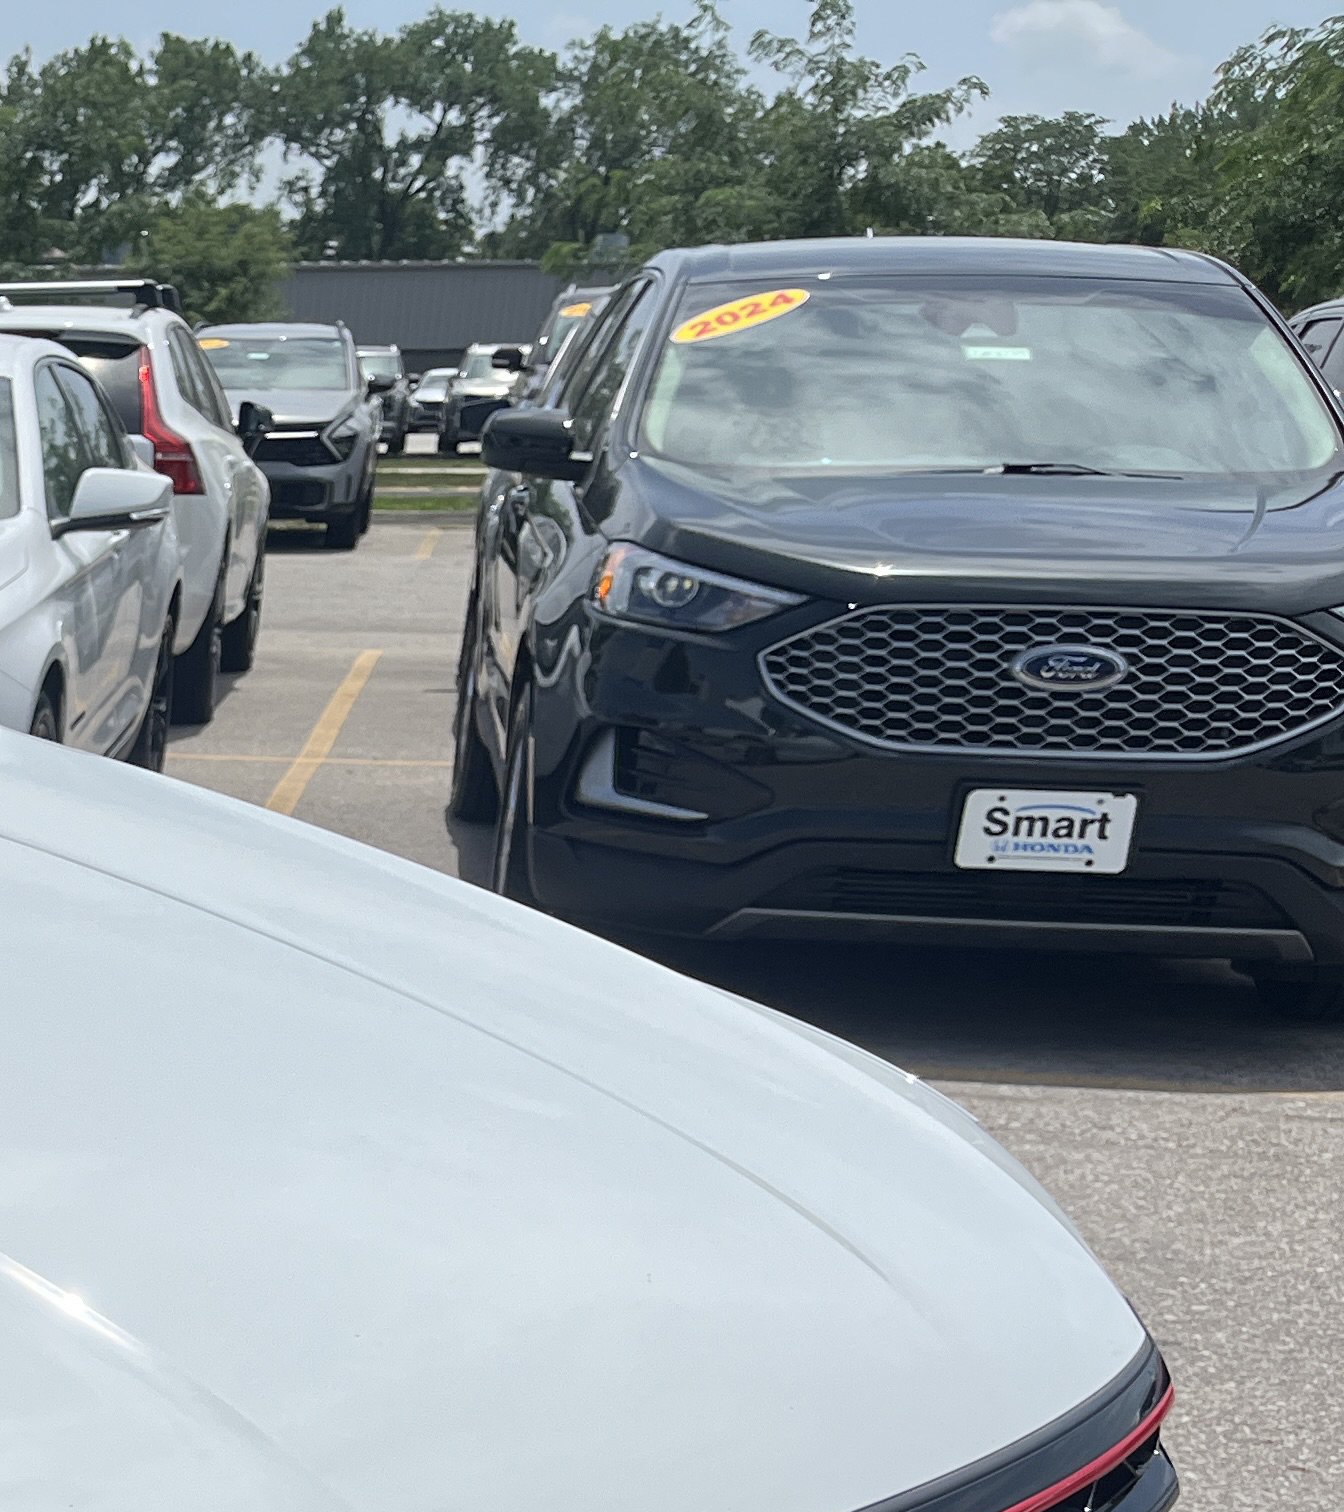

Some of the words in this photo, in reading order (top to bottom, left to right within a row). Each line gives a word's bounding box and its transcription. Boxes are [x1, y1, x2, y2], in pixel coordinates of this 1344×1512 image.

[689, 293, 796, 338] 2024
[1040, 654, 1103, 679] Ford
[983, 806, 1111, 840] Smart
[1013, 841, 1095, 855] HONDA
